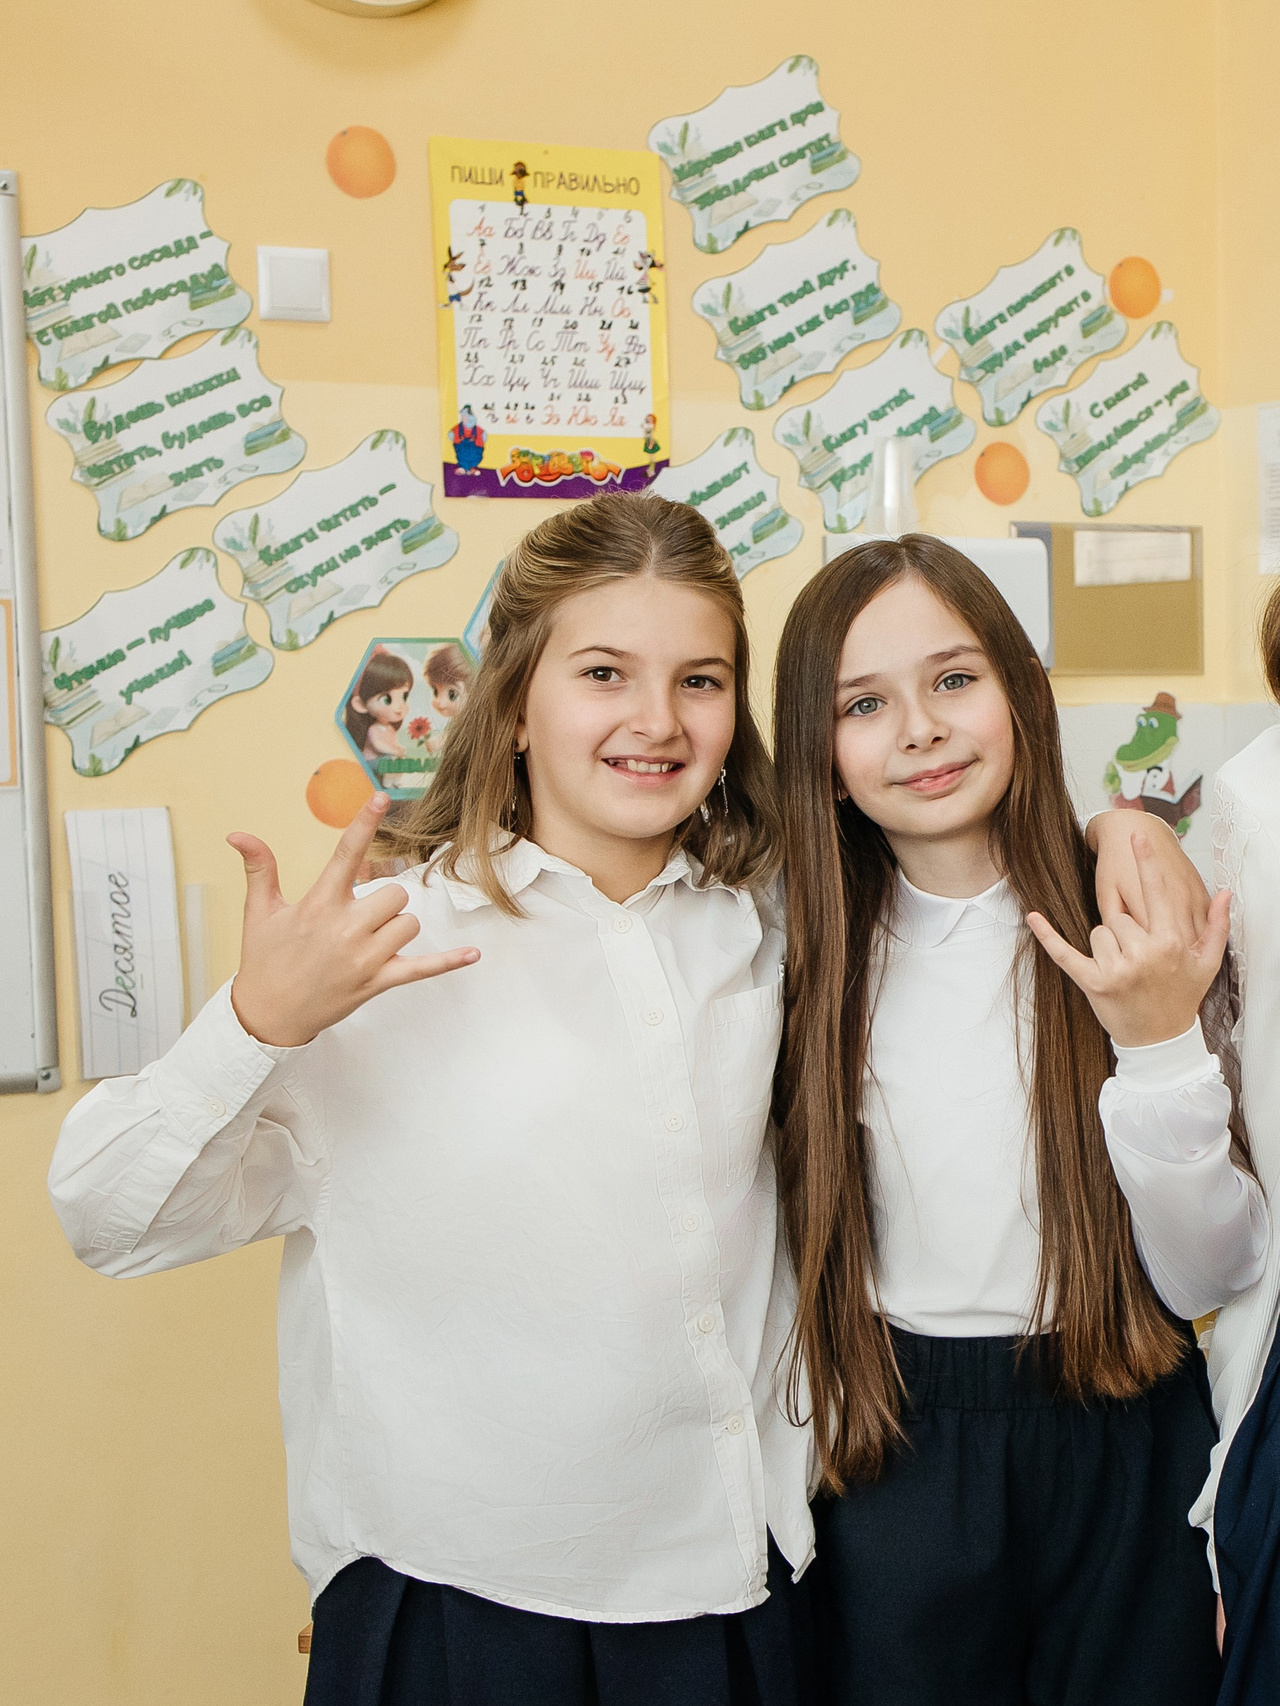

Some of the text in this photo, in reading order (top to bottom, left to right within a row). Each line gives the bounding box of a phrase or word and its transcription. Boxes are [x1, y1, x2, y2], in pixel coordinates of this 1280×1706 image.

[743, 118, 790, 149] книга
[790, 101, 825, 127] ярче
[450, 164, 642, 197] ПИШИ ПРАВИЛЬНО
[466, 216, 630, 252] Аа Бб Вв Гг Дд Ее
[497, 254, 542, 277] Жж
[574, 258, 598, 280] Ии
[472, 291, 631, 318] Кк Лл Мм Нн Оо
[727, 302, 779, 336] Книга
[776, 279, 817, 308] твой
[459, 326, 490, 349] Пп
[525, 329, 546, 352] Сс
[550, 330, 591, 353] Тт
[963, 310, 1009, 347] Книга
[462, 363, 496, 387] Хх
[502, 365, 532, 392] Цц
[567, 368, 603, 390] Шш
[98, 870, 138, 1019] Десятое
